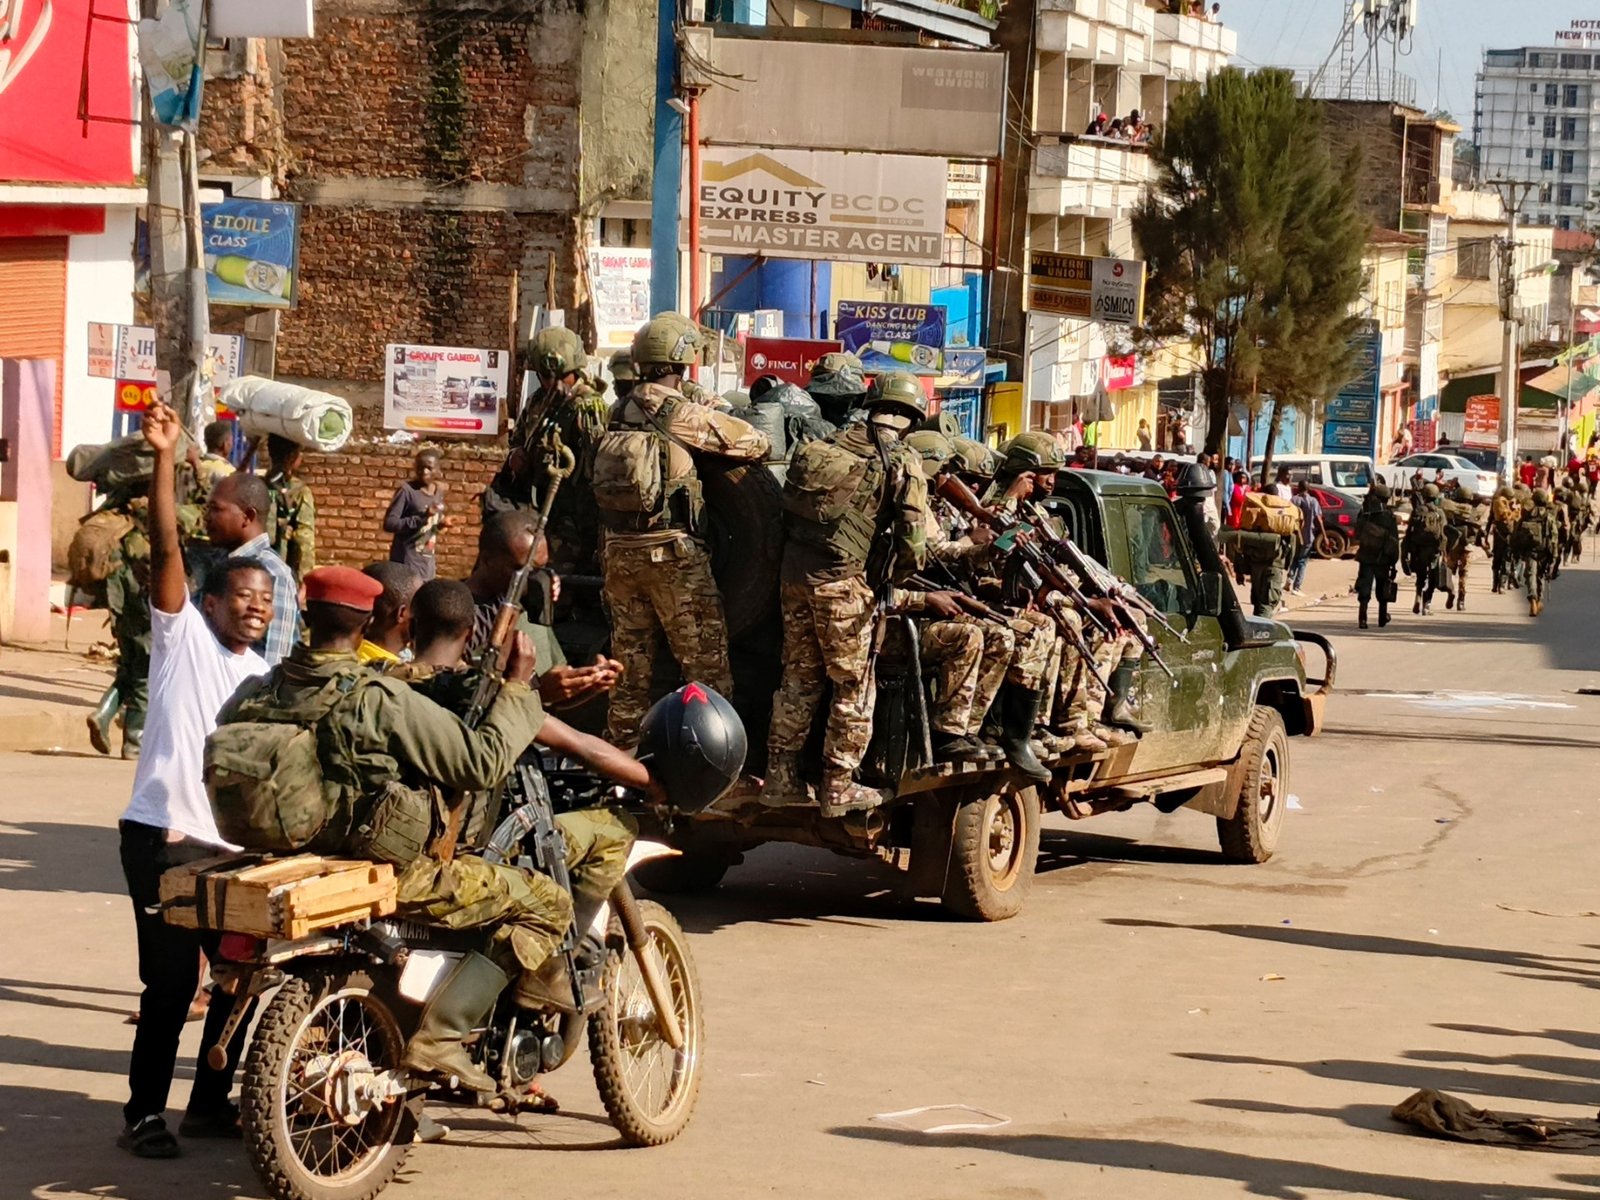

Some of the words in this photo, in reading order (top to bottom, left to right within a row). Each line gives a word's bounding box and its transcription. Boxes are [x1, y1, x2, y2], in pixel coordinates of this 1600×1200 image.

[1555, 30, 1581, 40] NEW
[912, 67, 985, 79] WESTERN
[934, 78, 985, 89] UNION
[700, 186, 826, 208] EQUITY
[831, 193, 924, 214] BCDC
[700, 206, 817, 224] EXPRESS
[213, 214, 271, 233] ETOILE
[209, 234, 248, 248] CLASS
[733, 225, 840, 248] MASTER
[847, 231, 937, 254] AGENT
[1032, 255, 1084, 269] WESTERN
[1048, 267, 1084, 279] UNION
[1103, 295, 1135, 315] SMICO
[855, 305, 886, 319] KISS
[890, 307, 927, 321] CLUB
[866, 321, 900, 330] DANCING
[885, 331, 911, 340] CLASS
[409, 351, 445, 361] GROUPE
[768, 360, 797, 370] FINCA
[385, 919, 430, 940] YAMAHA
